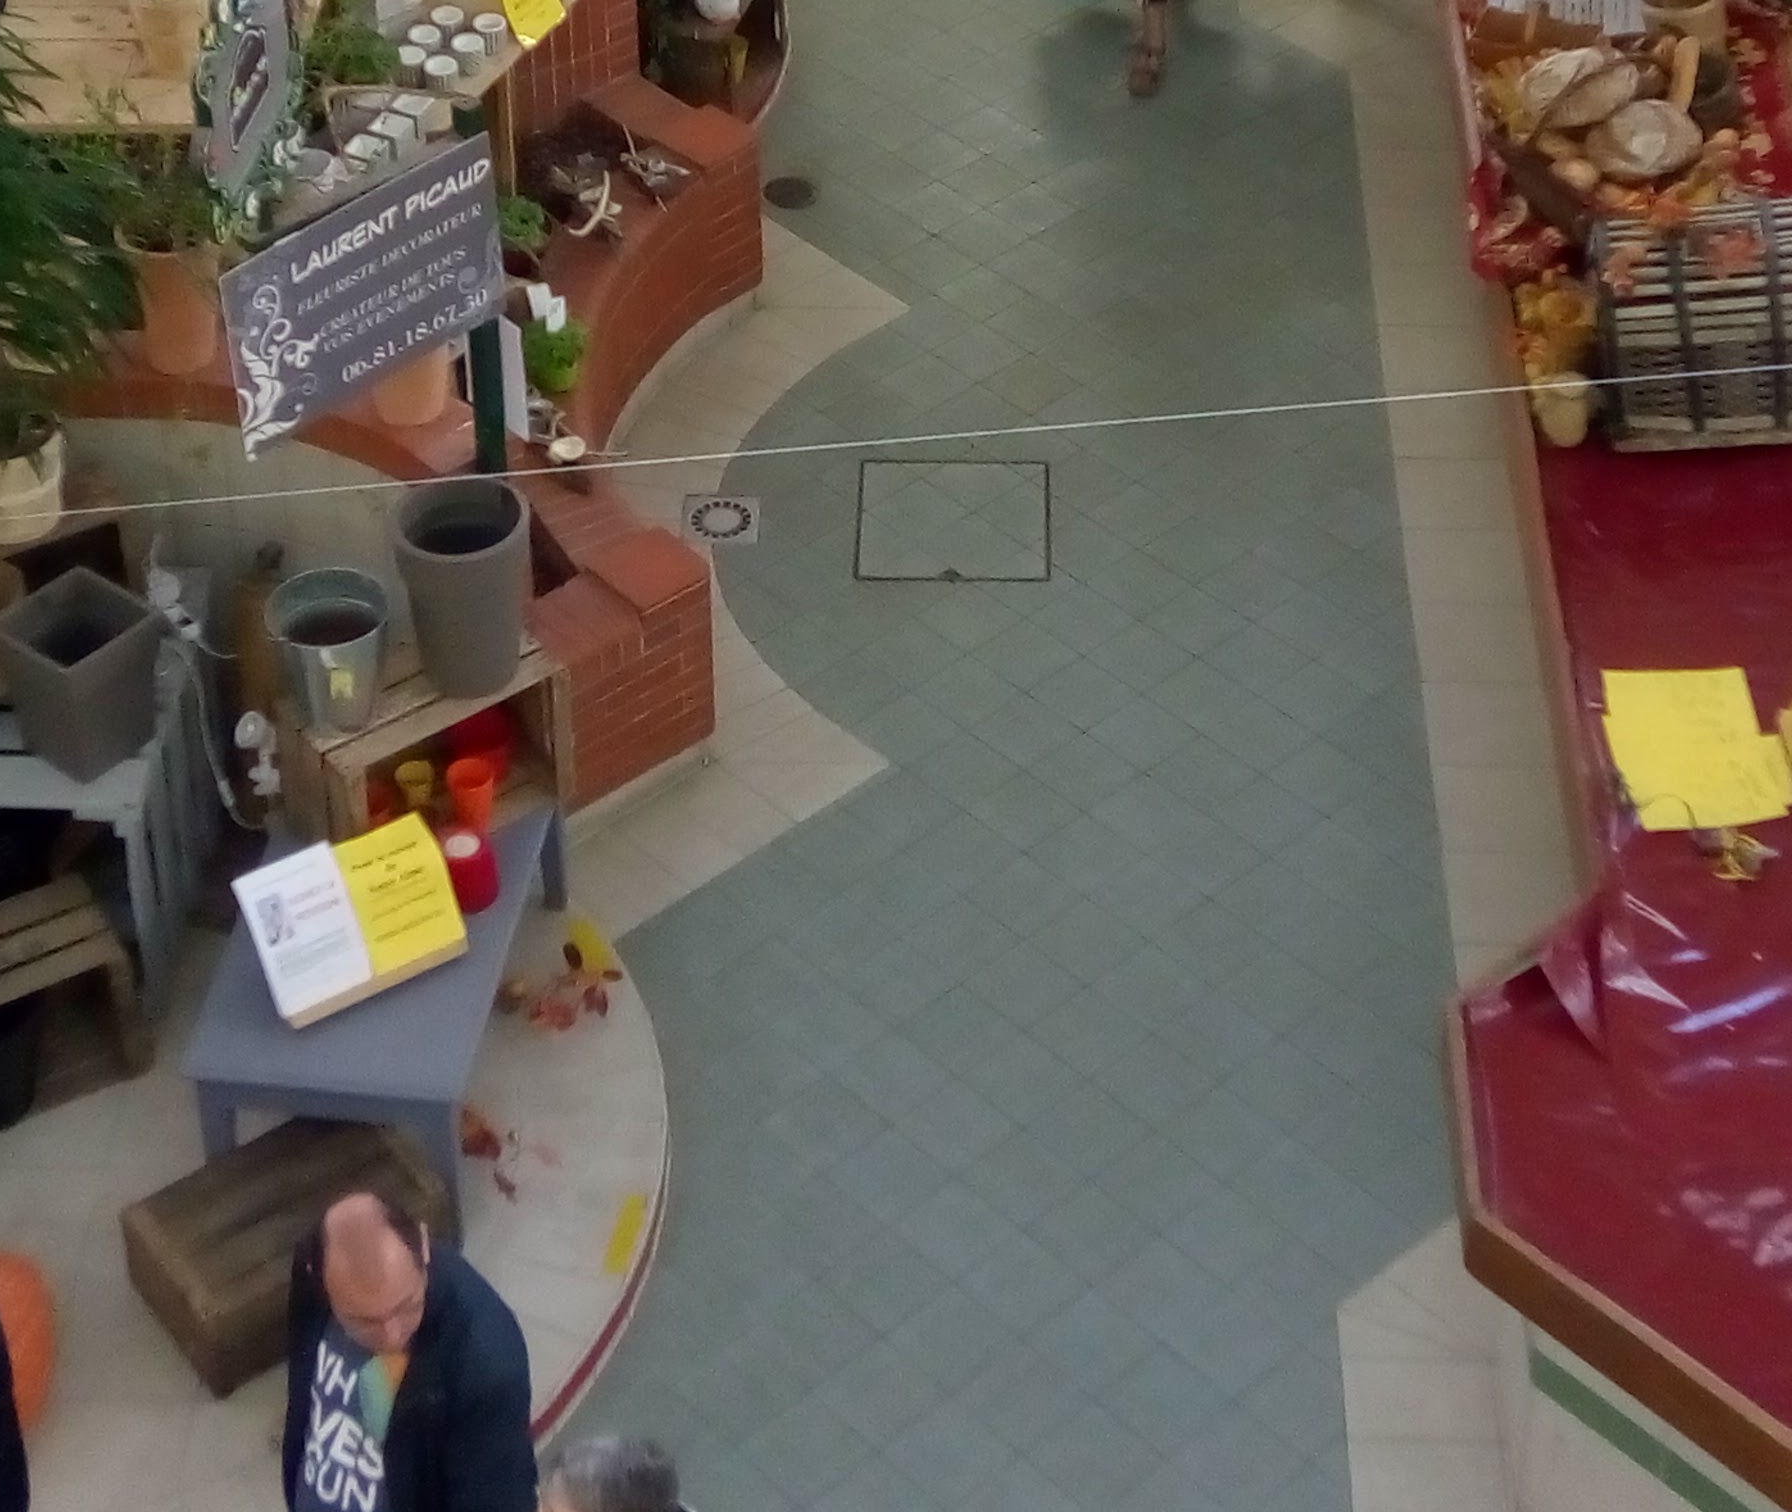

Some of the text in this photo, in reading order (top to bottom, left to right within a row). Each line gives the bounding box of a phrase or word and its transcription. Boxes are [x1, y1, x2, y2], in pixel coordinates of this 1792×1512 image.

[290, 157, 492, 284] LAURENT PICAUD
[296, 261, 378, 316] FLEURISTE
